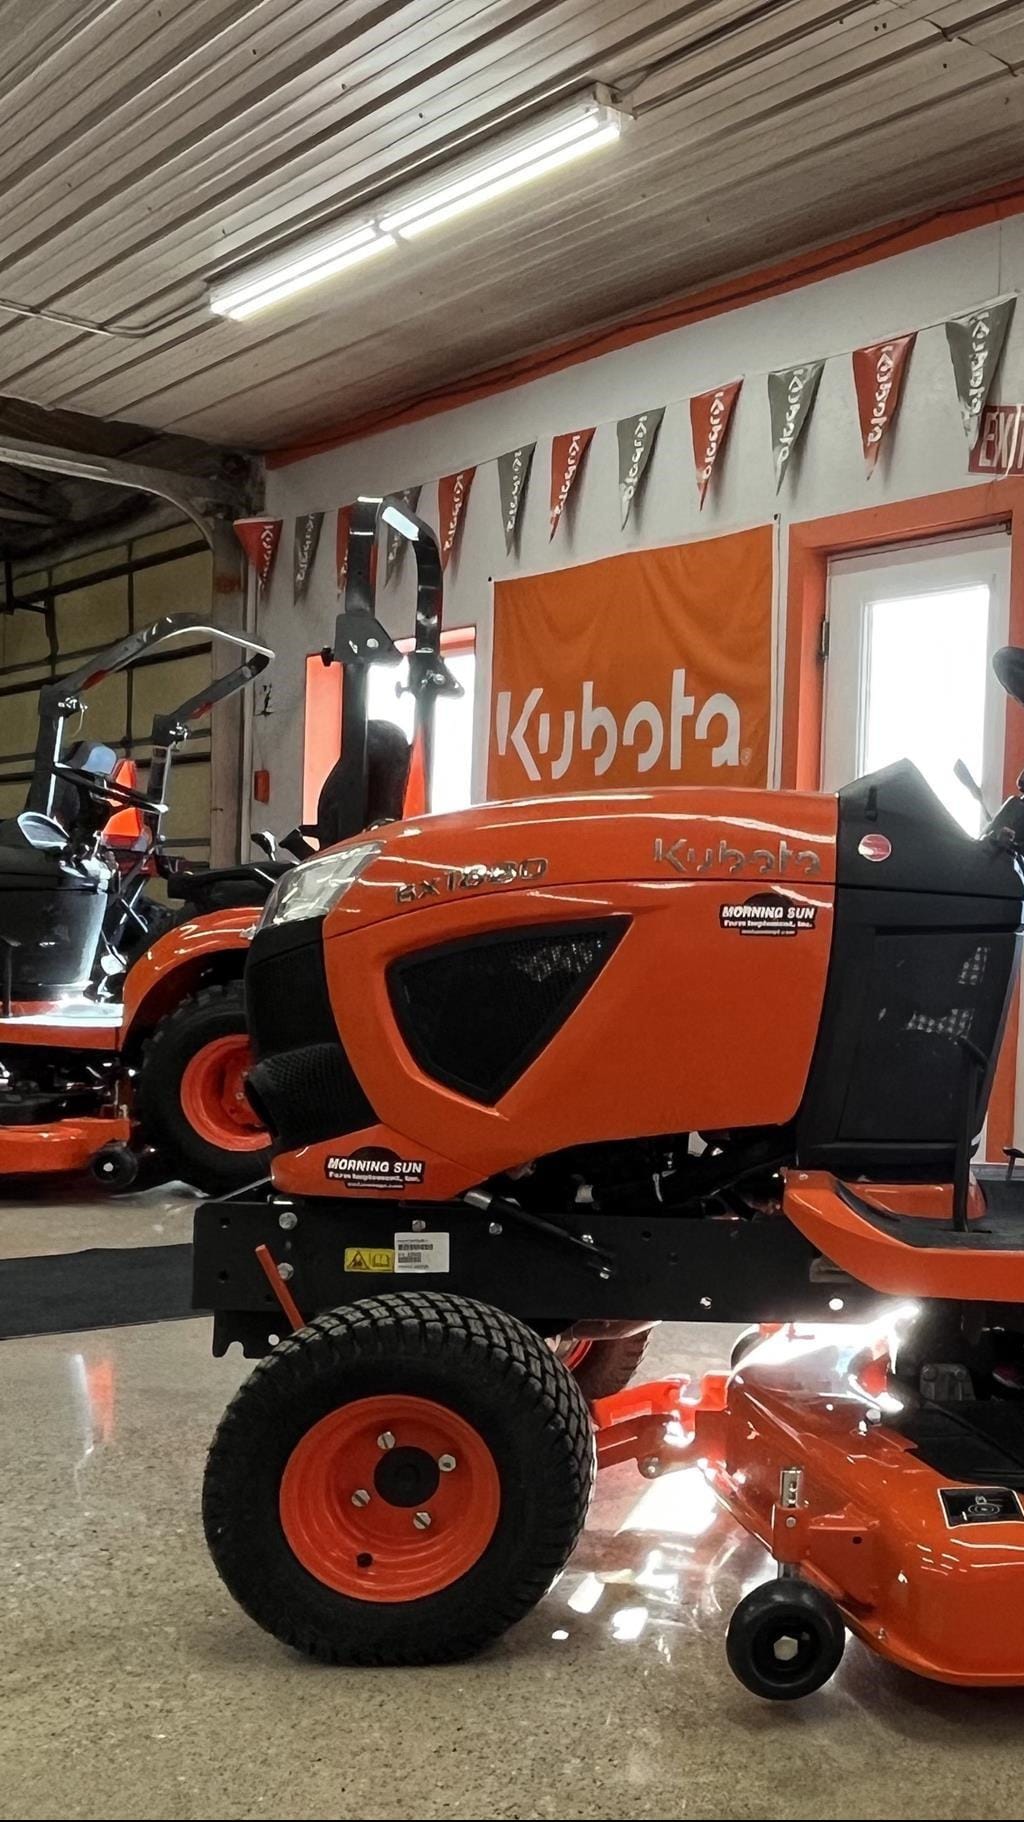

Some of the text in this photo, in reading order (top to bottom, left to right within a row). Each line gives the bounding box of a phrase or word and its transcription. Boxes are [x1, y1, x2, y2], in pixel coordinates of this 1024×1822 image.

[866, 346, 894, 447] Kubota
[495, 667, 742, 781] Kubota
[653, 837, 821, 875] Kubota
[721, 905, 815, 920] MORNING SUN
[326, 1157, 423, 1174] MORNING SUN
